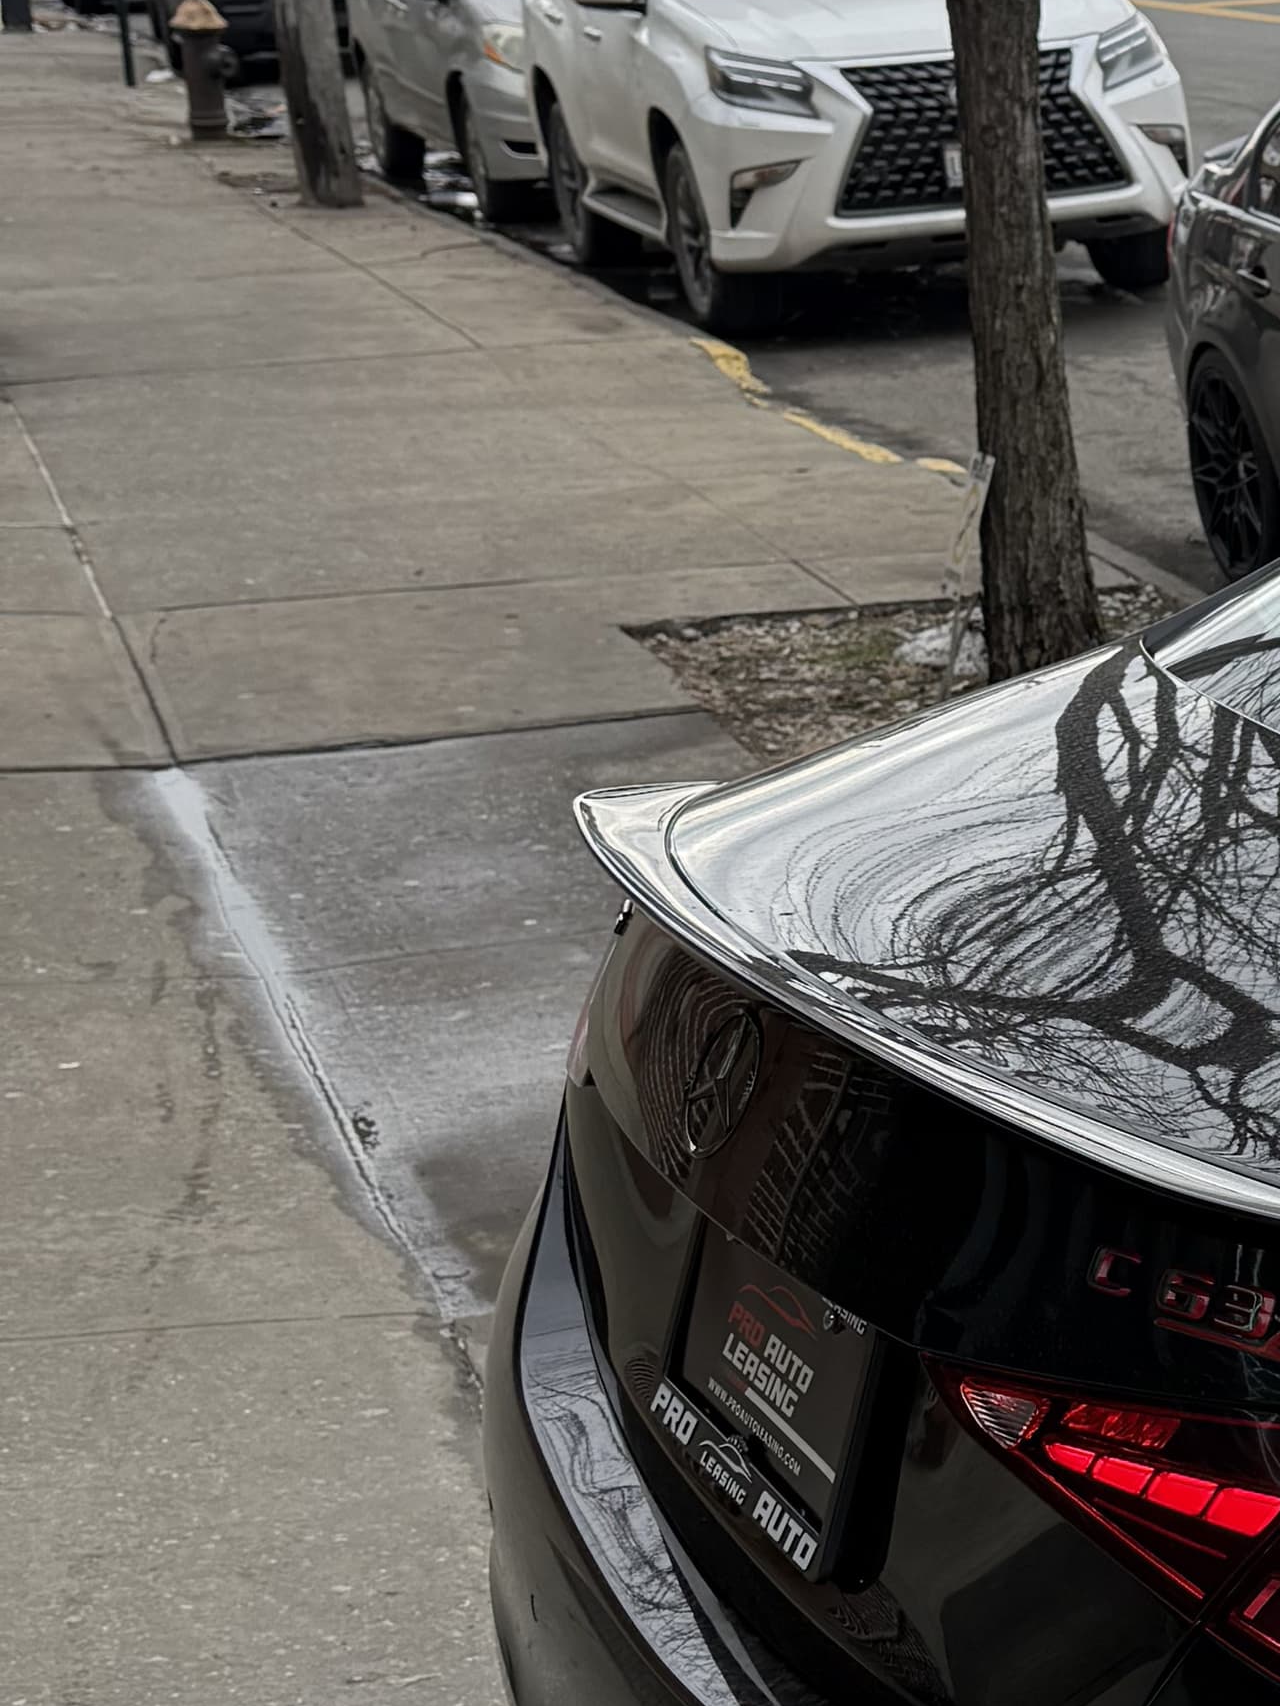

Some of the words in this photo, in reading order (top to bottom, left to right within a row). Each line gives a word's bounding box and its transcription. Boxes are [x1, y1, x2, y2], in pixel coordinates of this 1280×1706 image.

[1086, 1245, 1142, 1297] C
[721, 1332, 800, 1419] LEASING
[727, 1300, 766, 1349] PRO
[763, 1333, 815, 1394] AUTO
[650, 1382, 699, 1446] PRO
[699, 1450, 747, 1506] LEASING
[752, 1491, 819, 1571] AUTO
